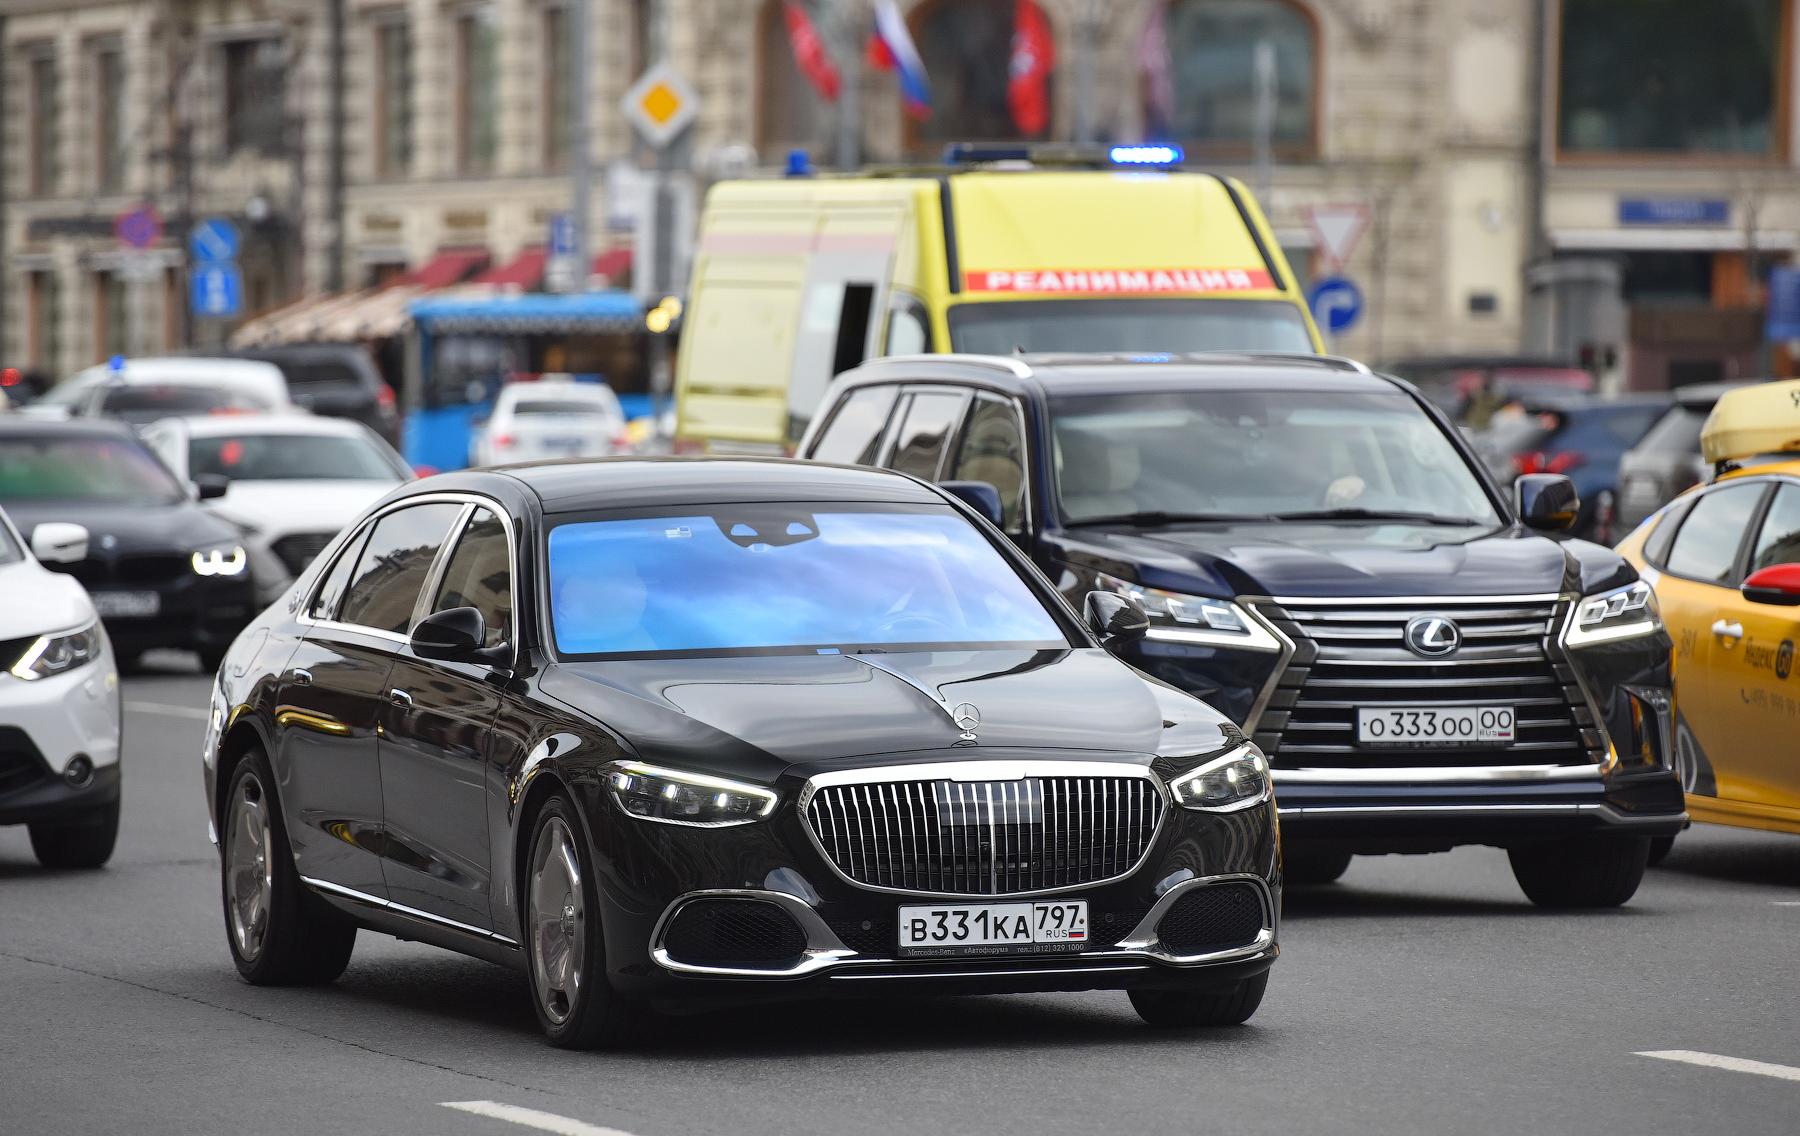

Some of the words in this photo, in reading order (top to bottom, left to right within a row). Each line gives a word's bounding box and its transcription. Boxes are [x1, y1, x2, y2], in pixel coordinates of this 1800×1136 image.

[986, 270, 1252, 292] РЕАНИМАЦИЯ
[1035, 904, 1080, 930] 797
[1045, 929, 1068, 938] RUS
[907, 947, 956, 957] Mercedes-Benz
[1052, 943, 1066, 952] 329
[1068, 943, 1085, 951] 1000
